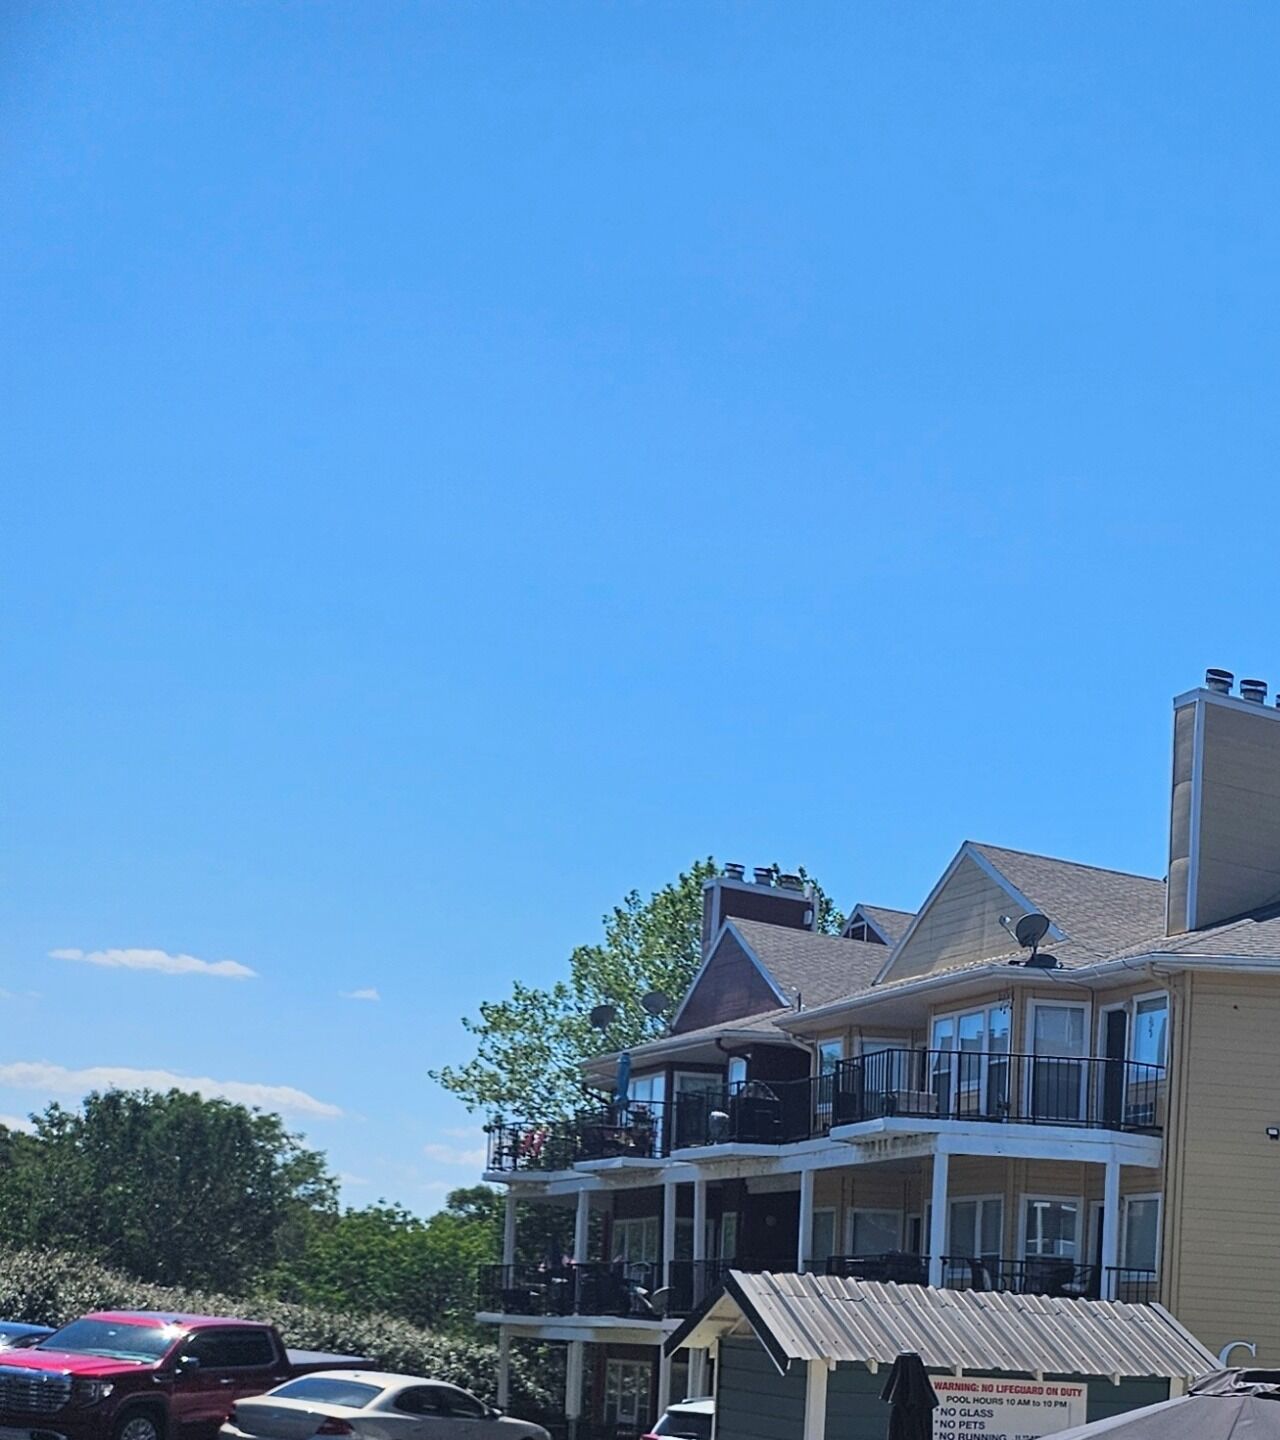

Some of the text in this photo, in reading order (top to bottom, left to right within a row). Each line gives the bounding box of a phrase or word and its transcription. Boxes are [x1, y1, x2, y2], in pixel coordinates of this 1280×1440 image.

[934, 1381, 1082, 1397] WARNING: NO LIFEGUARD ON DUTY
[946, 1395, 971, 1404] POOL
[973, 1397, 1004, 1405] HOURS
[1043, 1400, 1053, 1408] 10
[940, 1408, 994, 1418] NO GLASS
[940, 1420, 985, 1430] NO PETS
[939, 1432, 955, 1440] NO
